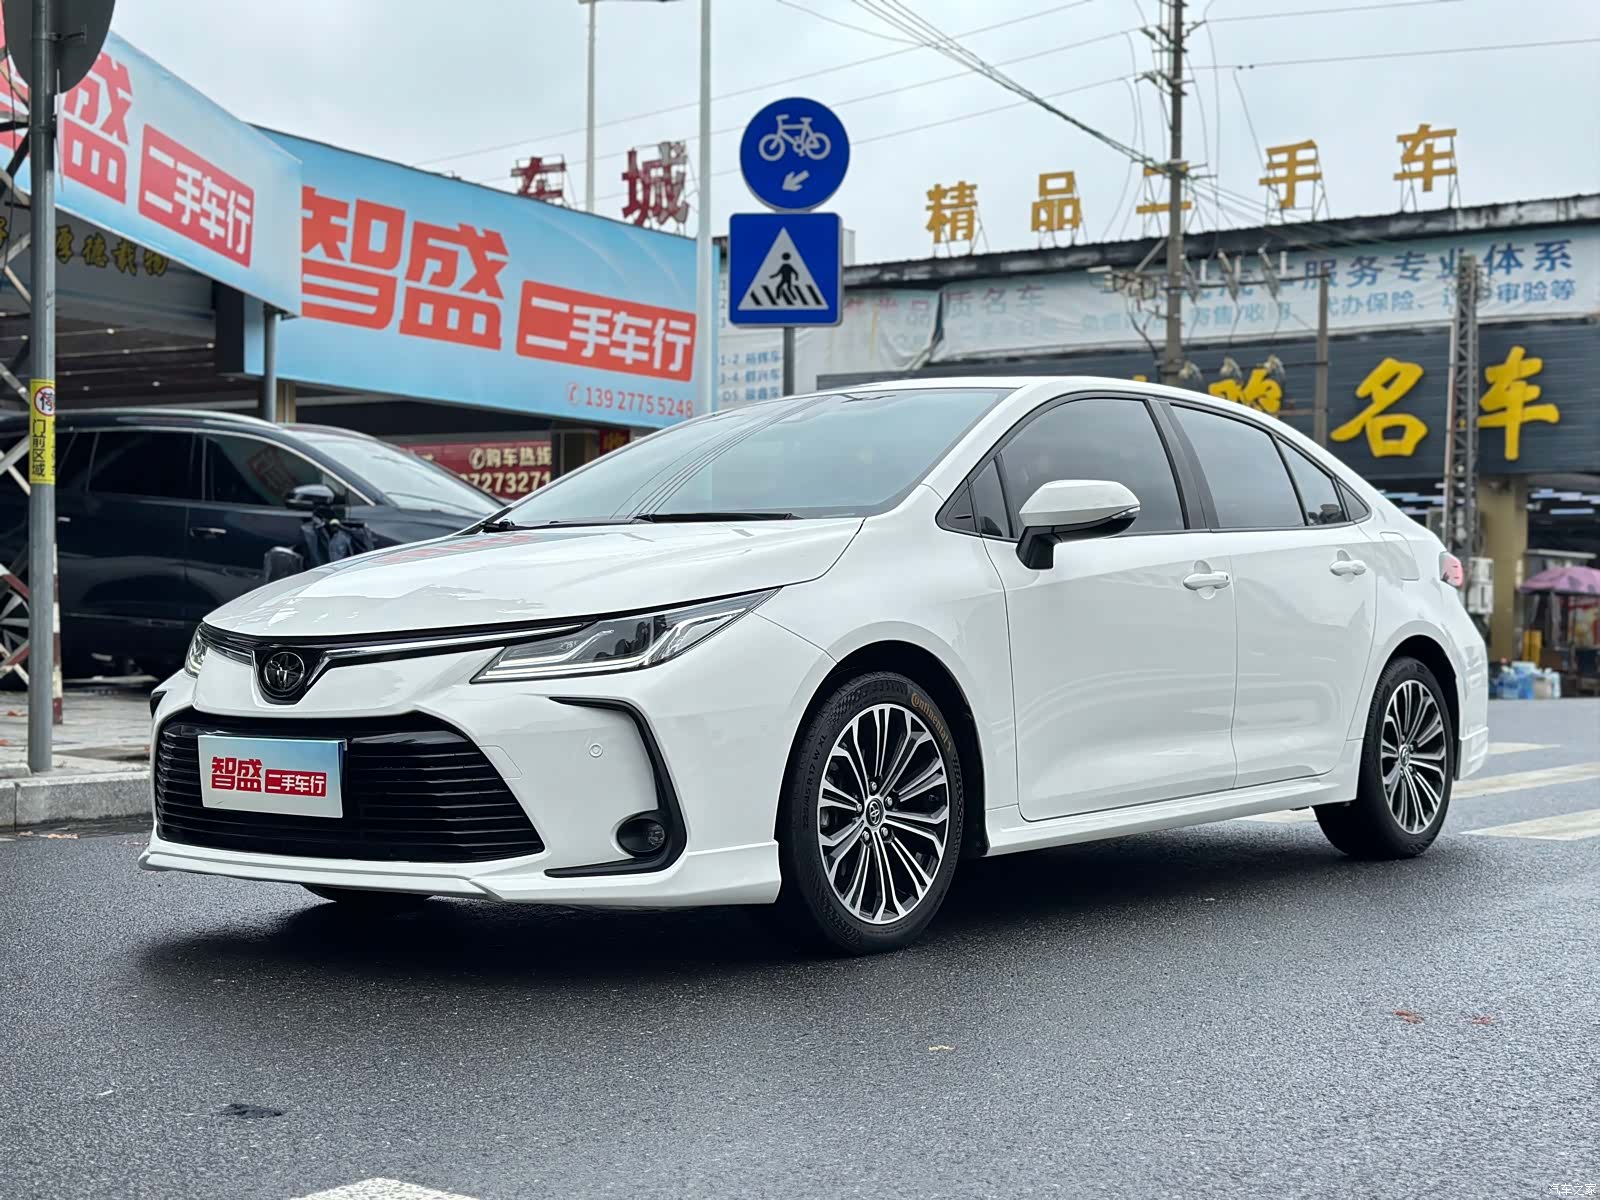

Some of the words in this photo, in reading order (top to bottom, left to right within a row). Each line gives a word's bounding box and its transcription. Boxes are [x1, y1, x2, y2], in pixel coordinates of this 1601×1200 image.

[145, 145, 251, 254] 二手车行
[925, 123, 1458, 243] 精品二手车
[302, 185, 509, 351] 智盛
[526, 296, 692, 372] 二手车行
[585, 386, 613, 408] 139
[617, 391, 654, 414] 2775
[658, 396, 693, 418] 5248
[32, 419, 46, 477] 门前区域
[486, 446, 552, 468] 购车热线
[460, 471, 552, 494] 7273271
[911, 692, 949, 746] Continental
[211, 757, 262, 792] 智盛
[268, 774, 325, 793] 二手车行
